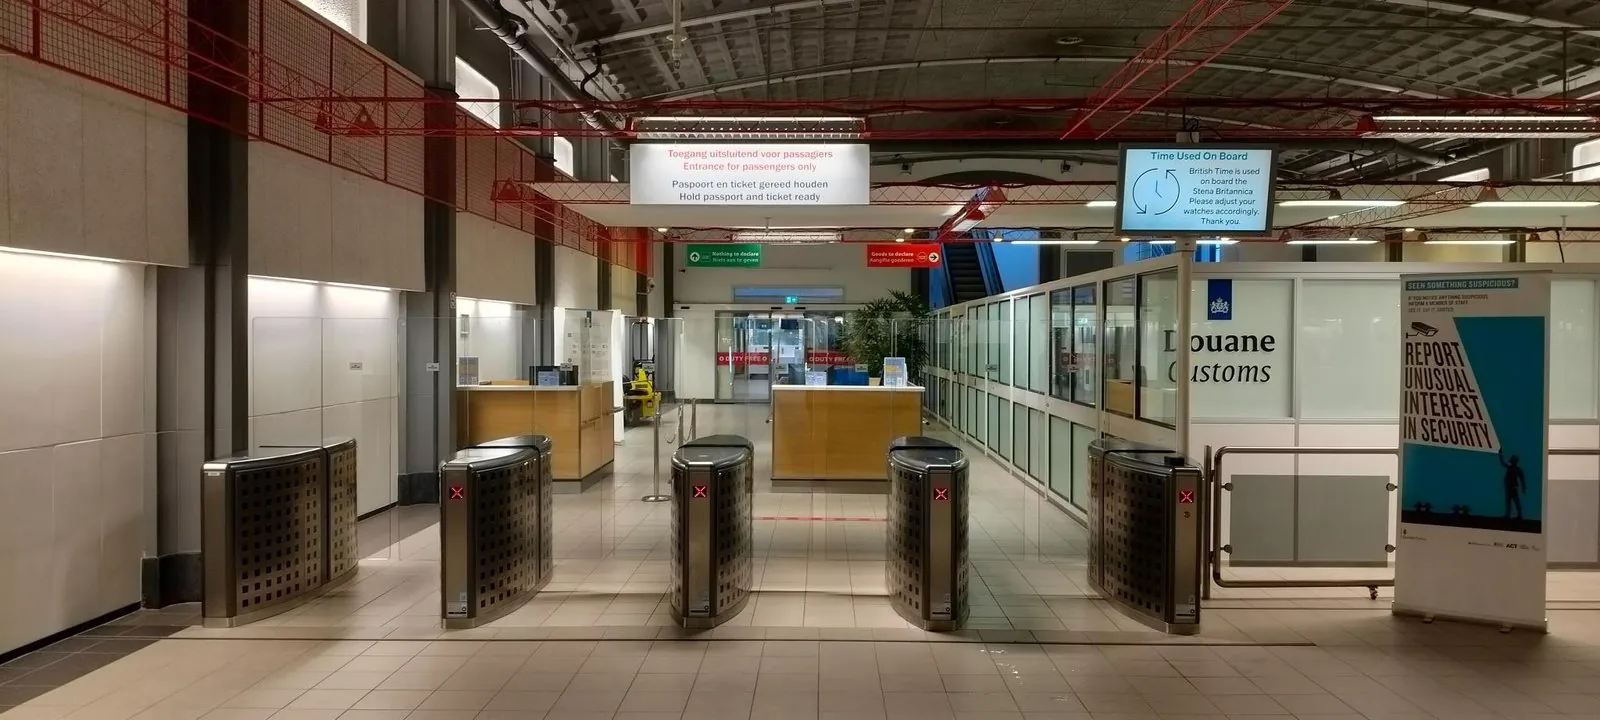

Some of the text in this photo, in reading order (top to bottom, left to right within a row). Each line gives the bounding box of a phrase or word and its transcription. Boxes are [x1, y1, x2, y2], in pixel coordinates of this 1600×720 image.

[668, 150, 707, 160] Toegang
[710, 150, 758, 158] uitsluitend
[783, 150, 833, 160] passagiers
[1151, 152, 1248, 160] Time Used On Board
[683, 162, 817, 172] Entrance for passengers only
[672, 180, 714, 190] Paspoort
[730, 180, 756, 188] ticket
[759, 180, 790, 190] gereed
[794, 180, 828, 188] houden
[679, 192, 821, 202] Hold passport and ticket ready
[1215, 208, 1259, 217] accordingly.
[1427, 281, 1467, 289] SOMETHING
[1468, 280, 1515, 288] SUSPICIOUS?
[1406, 342, 1465, 367] REPORT
[1405, 367, 1475, 393] UNUSUAL
[1404, 391, 1483, 420] INTEREST
[1403, 416, 1492, 448] IN SECURITY
